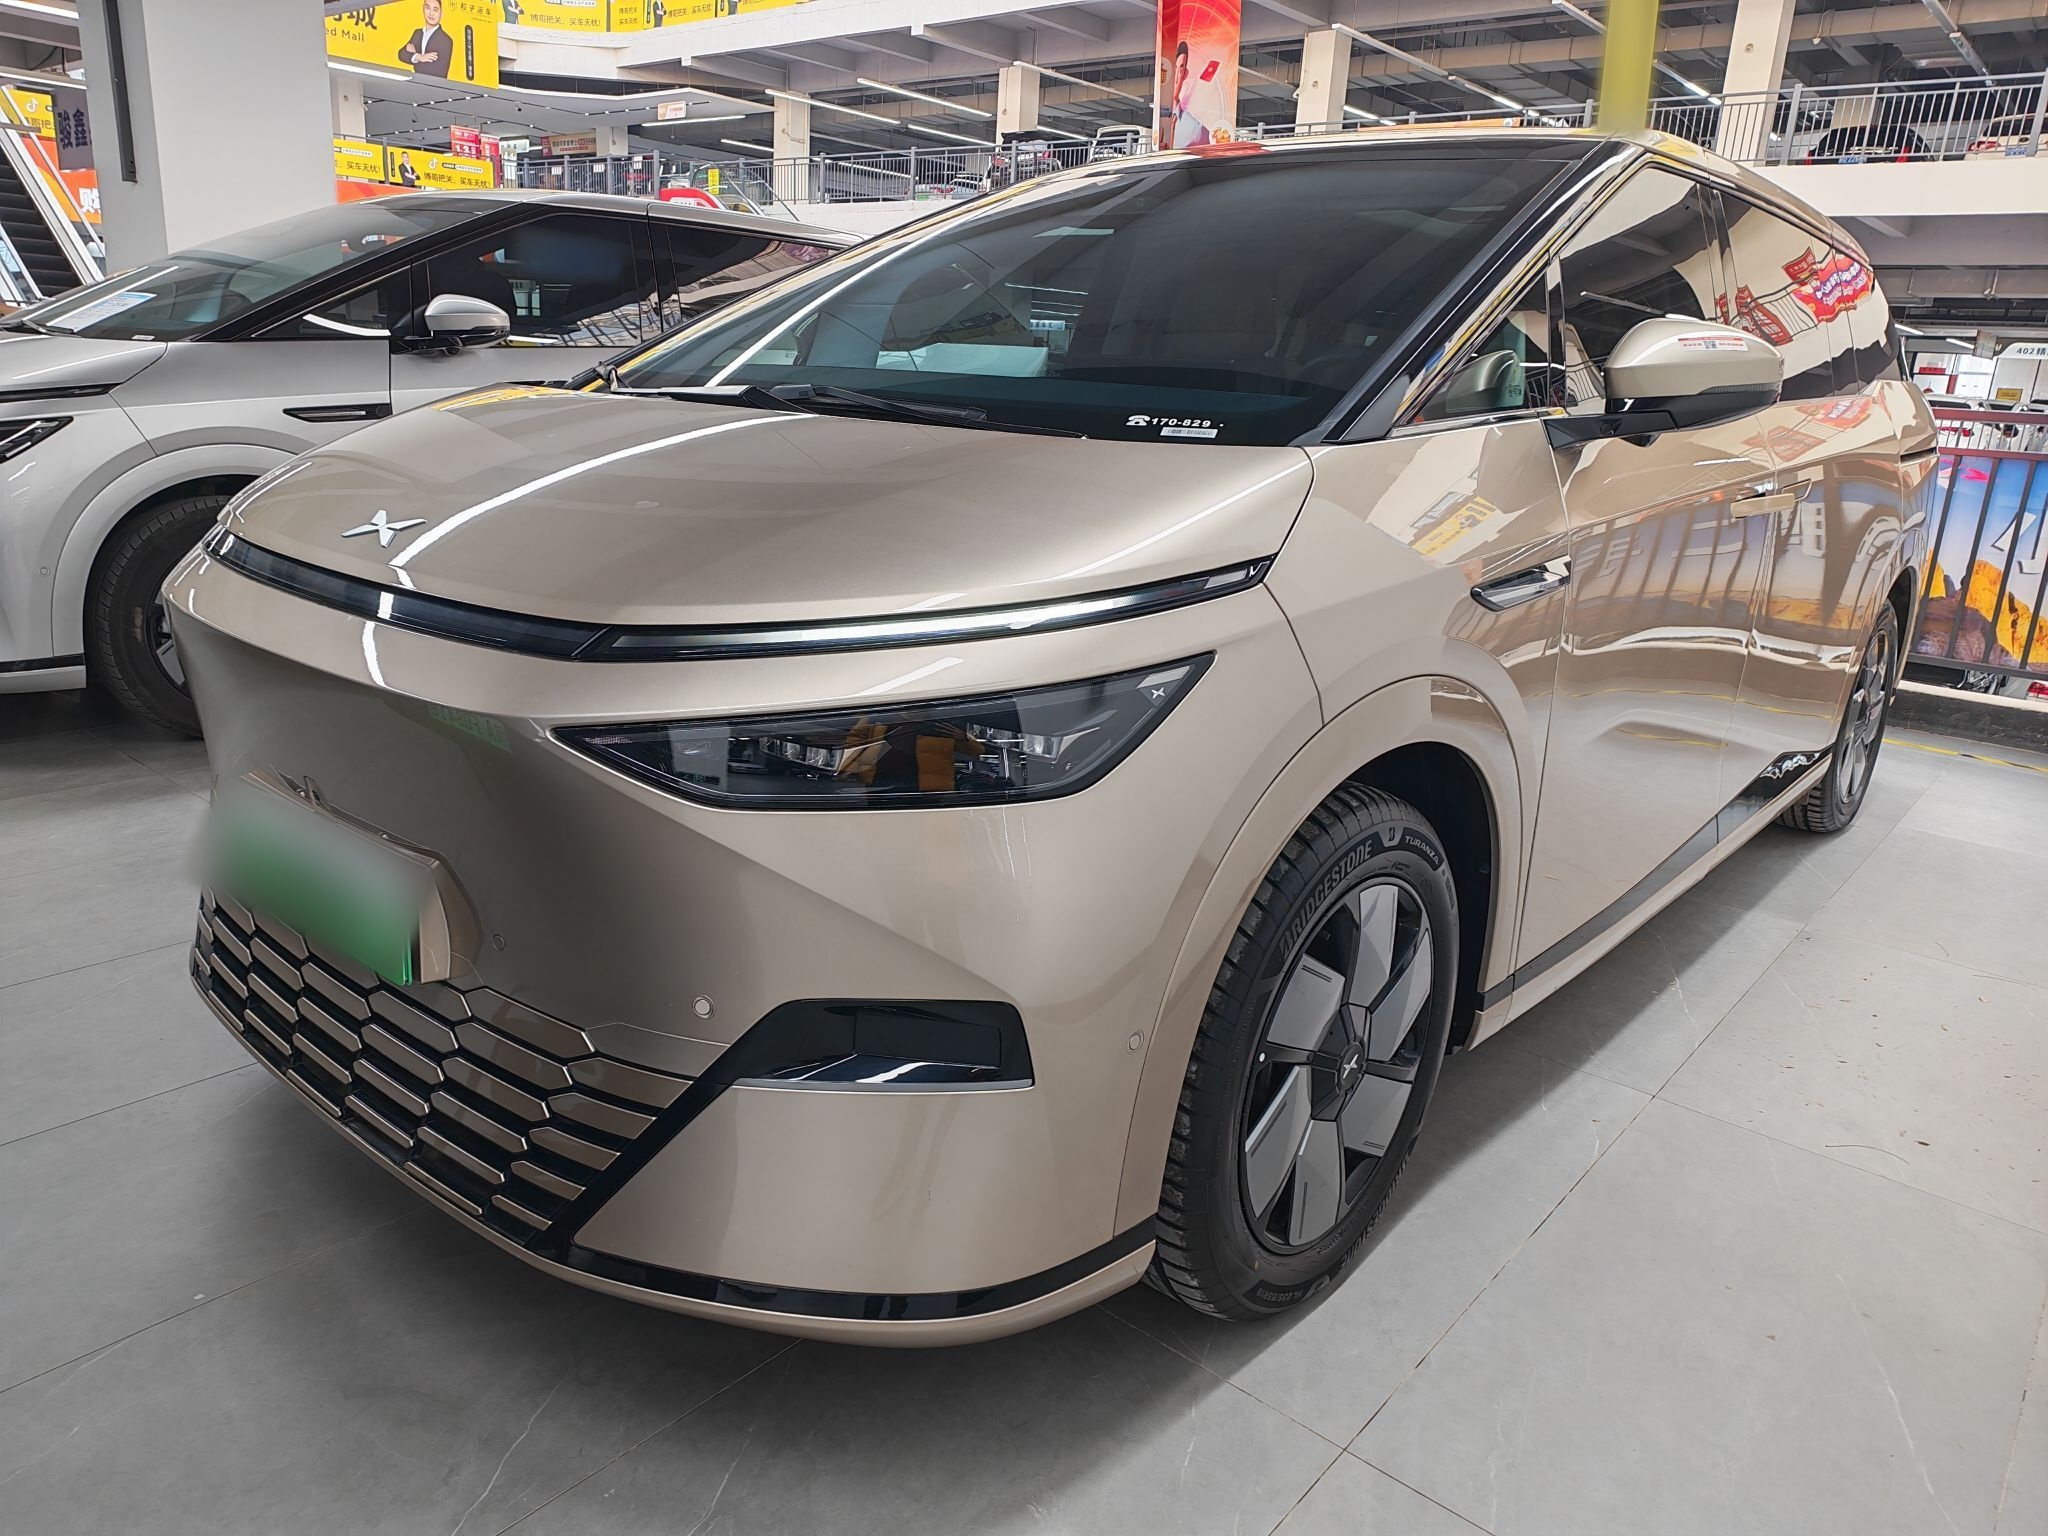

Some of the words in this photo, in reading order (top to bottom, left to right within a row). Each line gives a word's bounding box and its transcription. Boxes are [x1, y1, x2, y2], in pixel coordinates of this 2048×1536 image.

[333, 7, 377, 30] 城
[1404, 834, 1440, 866] TURANZA
[1278, 839, 1373, 957] BRIDGESTONE
